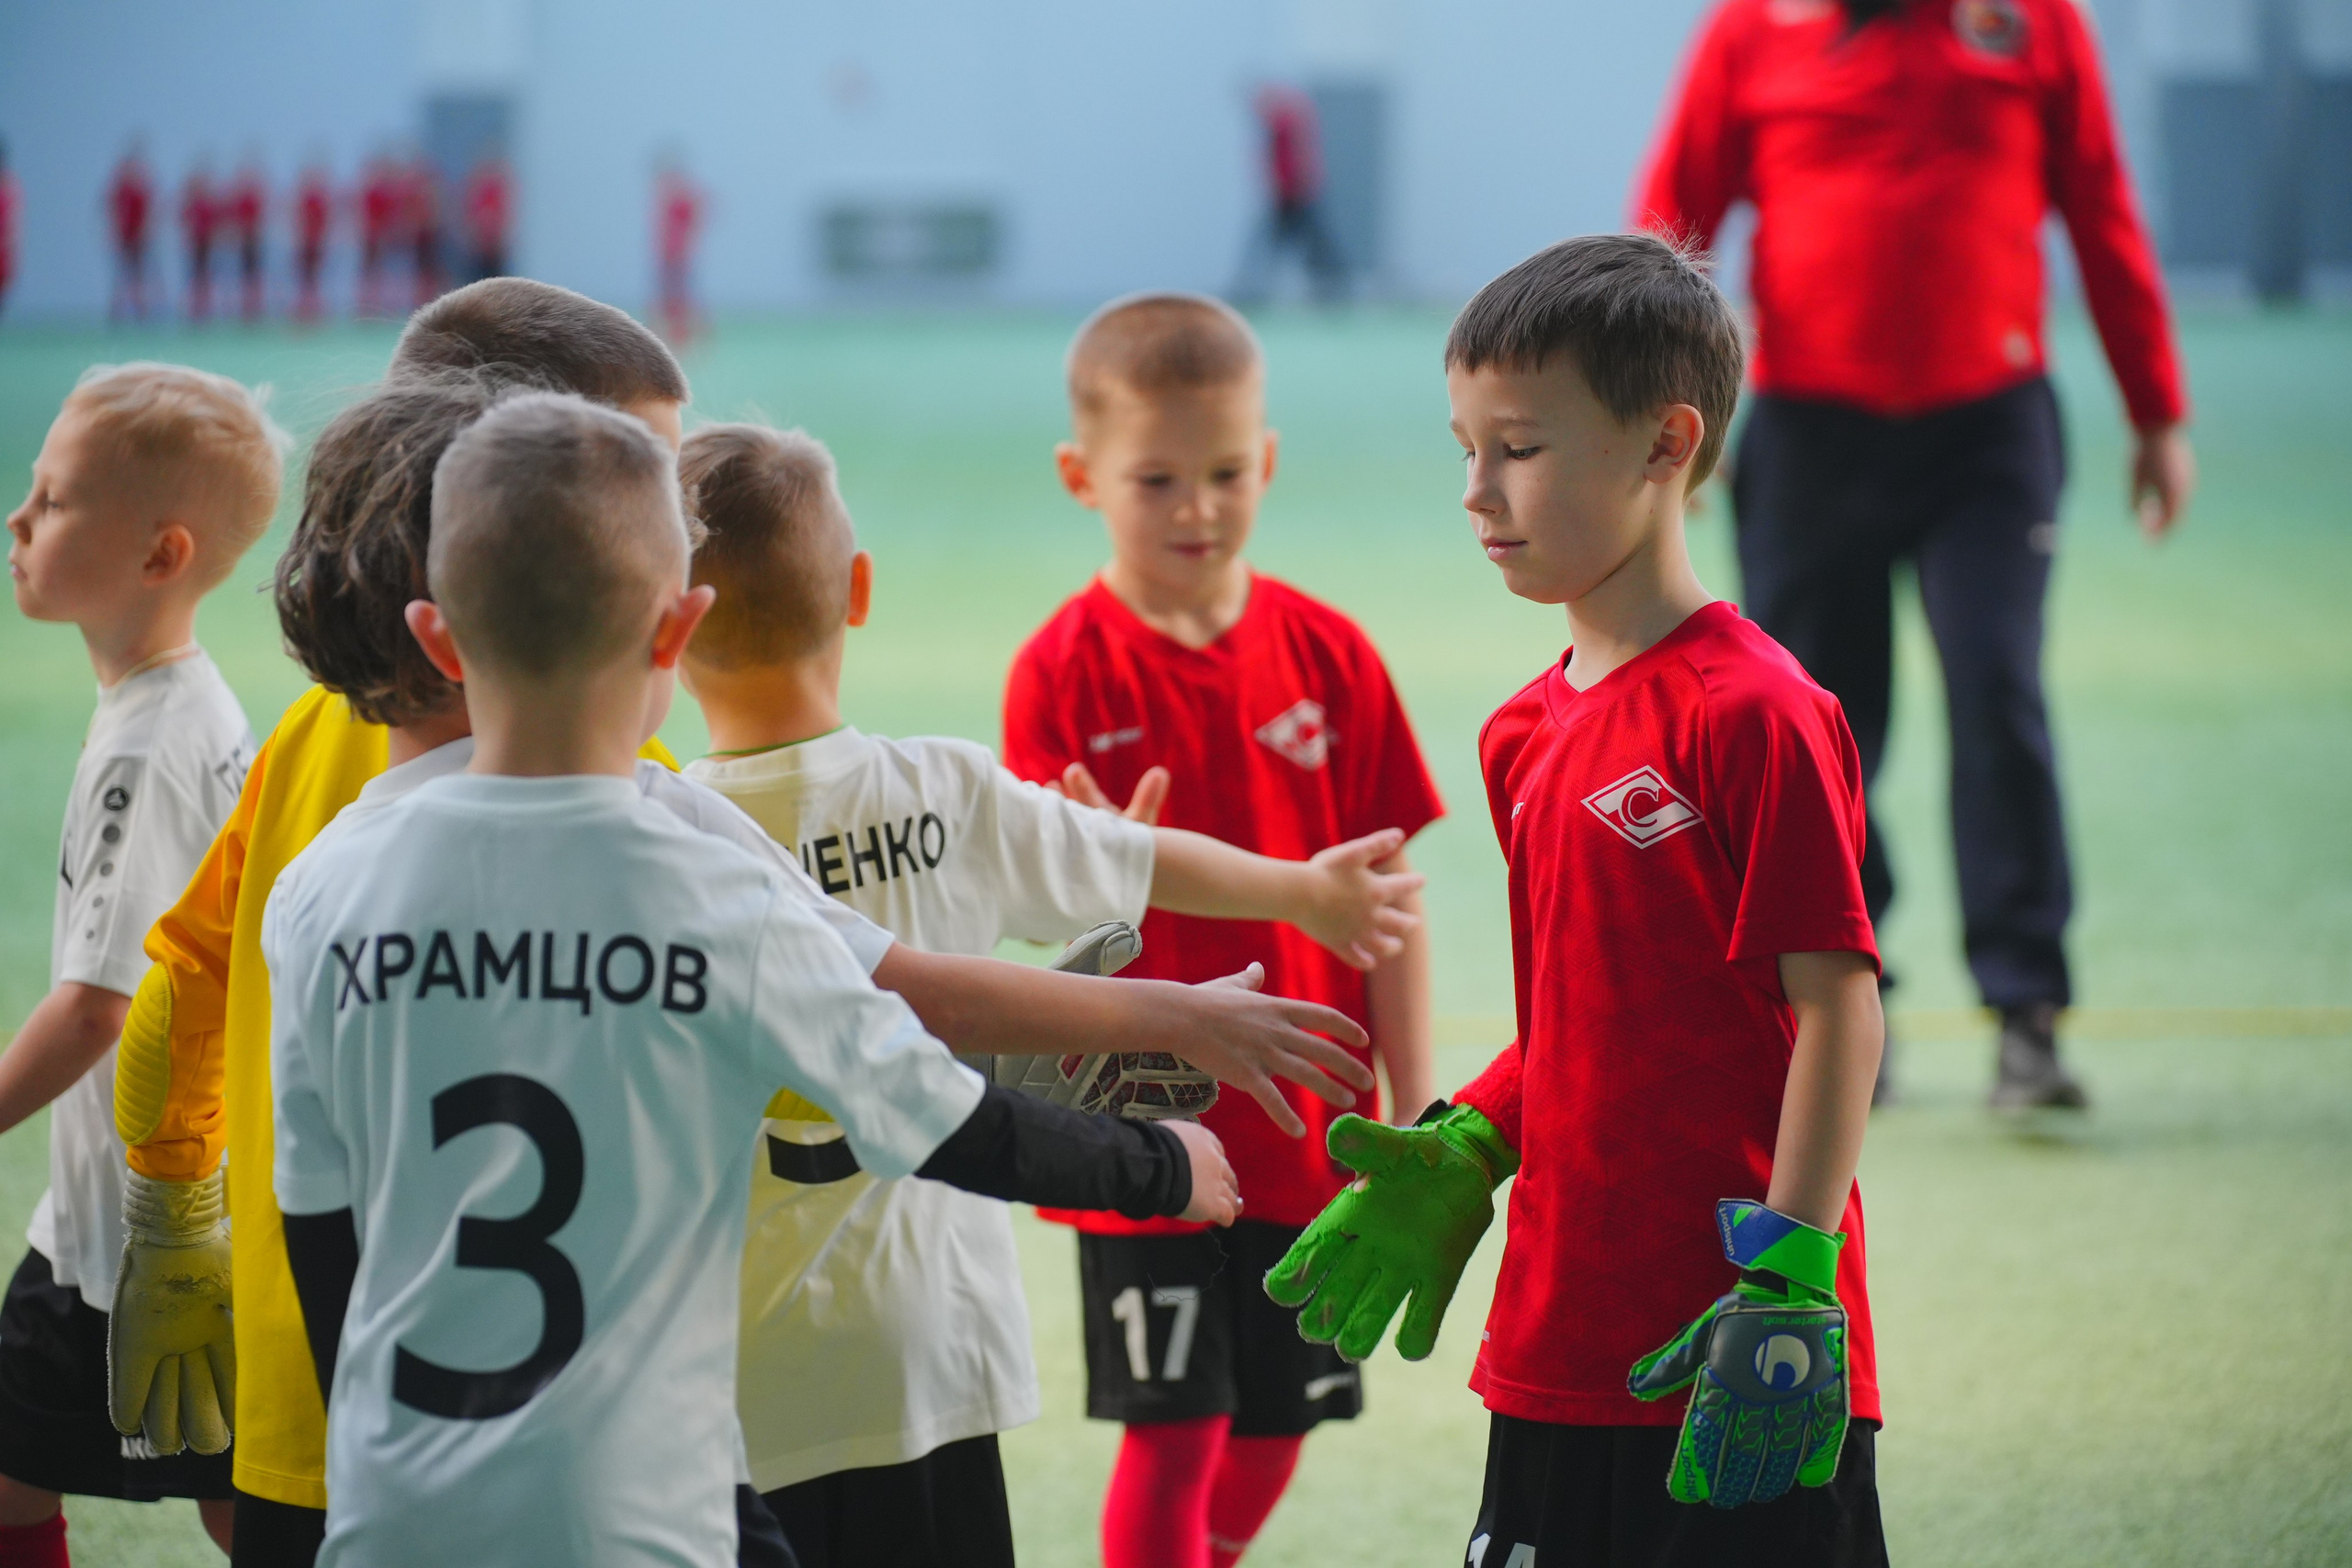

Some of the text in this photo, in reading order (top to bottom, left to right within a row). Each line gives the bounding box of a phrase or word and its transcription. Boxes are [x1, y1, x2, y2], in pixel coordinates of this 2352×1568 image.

[331, 931, 707, 1016] ХРАМЦОВ
[392, 1072, 585, 1421] 3
[1718, 1206, 1736, 1257] uhlsport
[1111, 1285, 1200, 1381] 17
